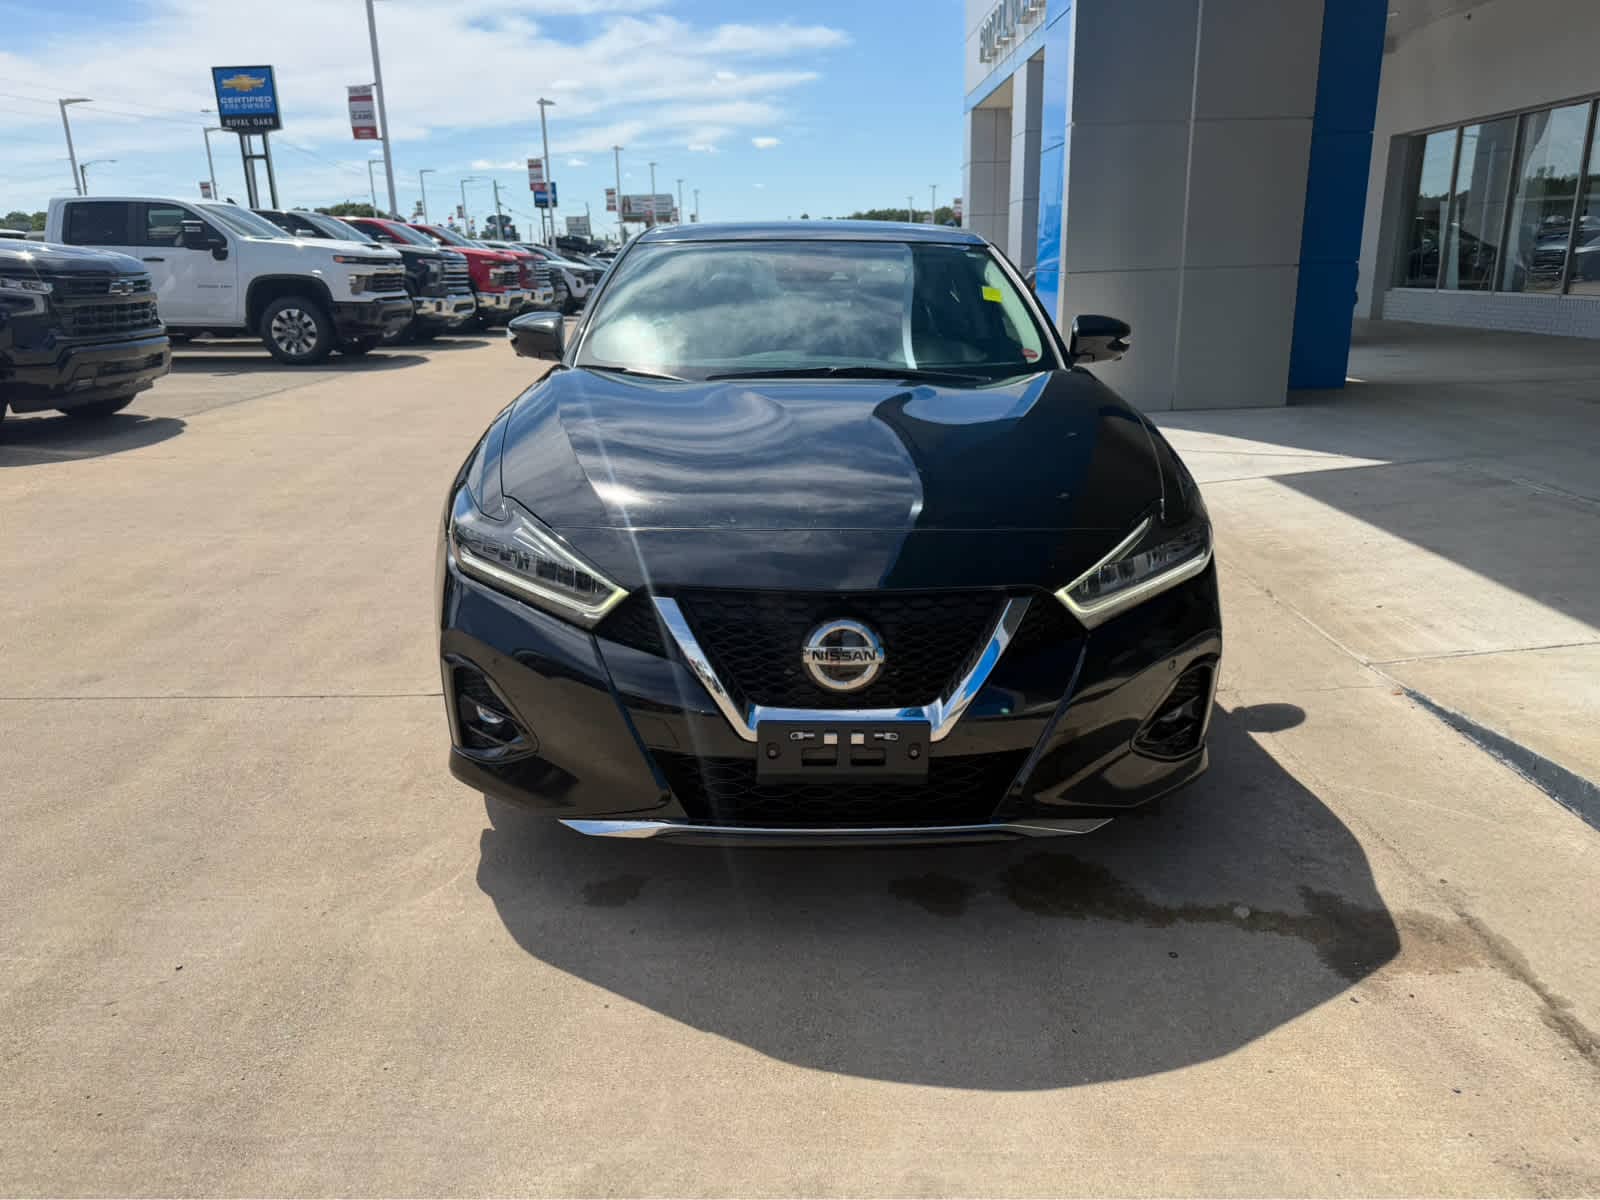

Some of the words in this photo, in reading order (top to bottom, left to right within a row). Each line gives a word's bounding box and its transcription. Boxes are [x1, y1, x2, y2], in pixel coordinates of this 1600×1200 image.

[220, 96, 272, 104] CERTIFIED
[225, 119, 250, 127] ROYAL
[812, 650, 876, 661] NISSAN
